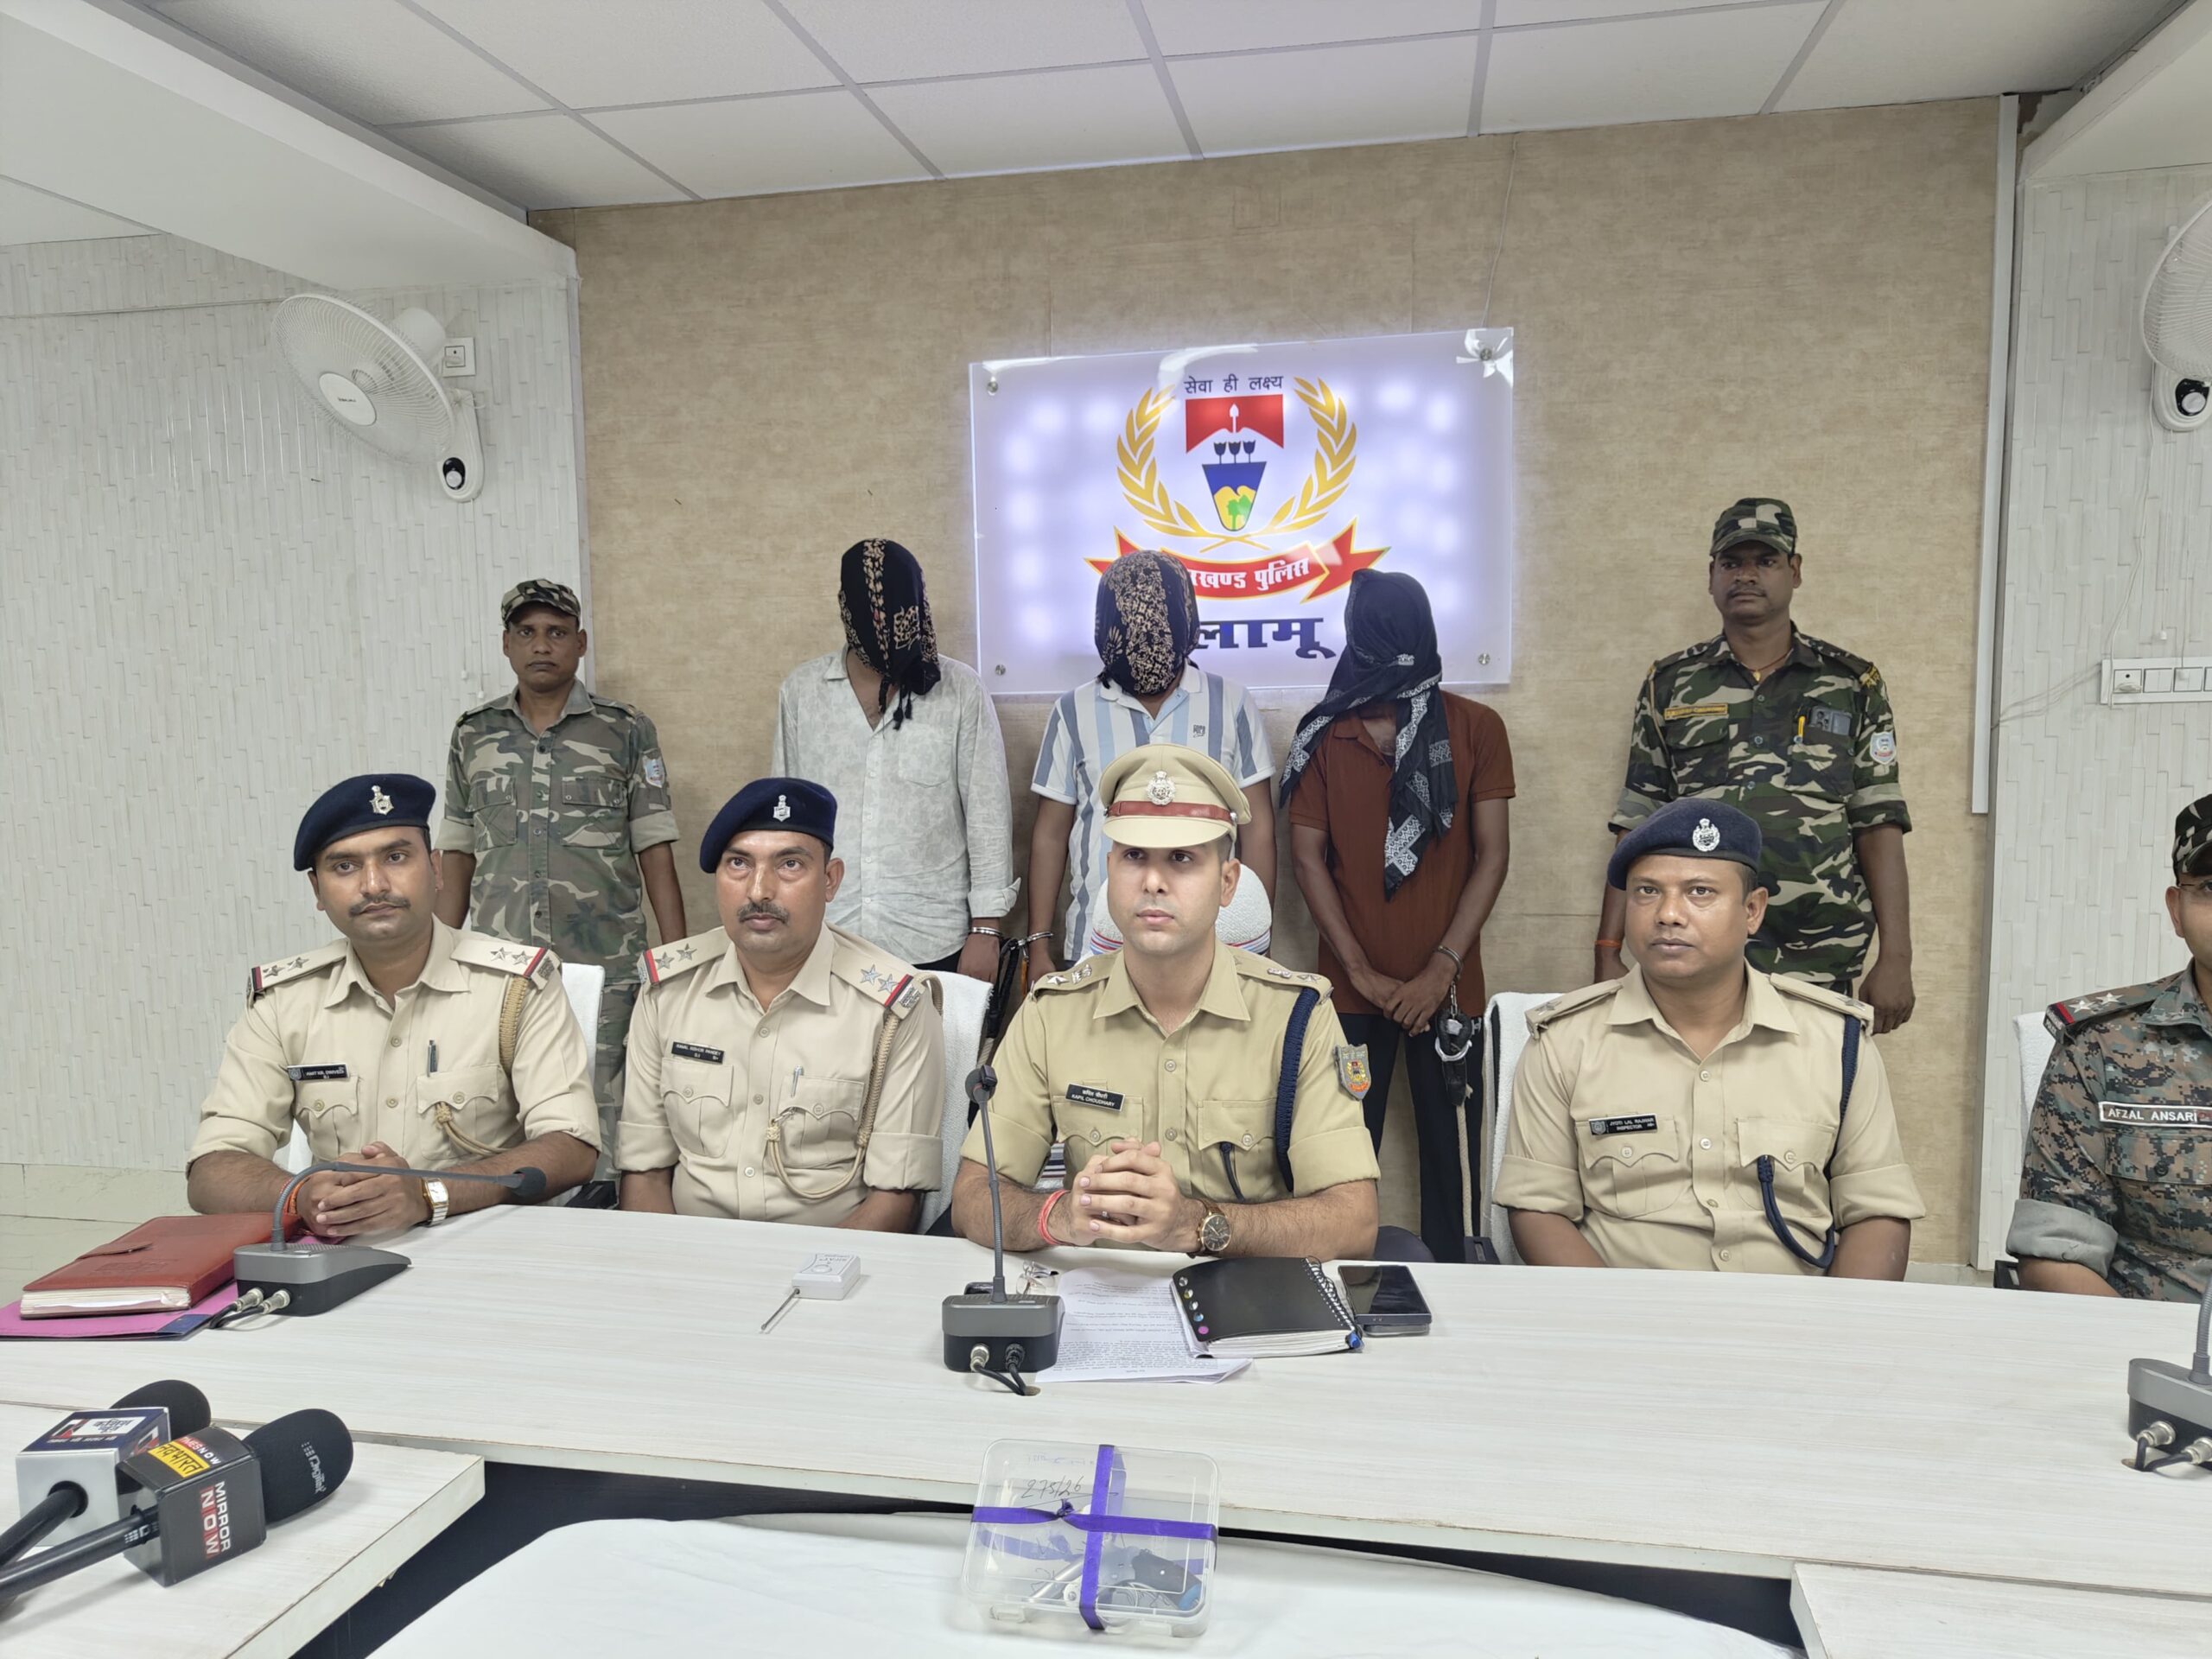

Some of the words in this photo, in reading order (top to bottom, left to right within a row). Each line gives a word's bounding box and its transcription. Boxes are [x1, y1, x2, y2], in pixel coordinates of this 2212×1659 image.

[1184, 375, 1213, 394] सेवा
[1223, 373, 1239, 393] ही
[1248, 376, 1284, 391] लक्ष्य
[1188, 569, 1247, 589] रखण्ड
[1254, 557, 1310, 591] पुलिस
[1196, 618, 1337, 659] लामू
[1085, 1096, 1116, 1107] CHOUDHARY
[2107, 1108, 2145, 1121] AFZAL
[2151, 1109, 2197, 1122] ANSARI
[200, 1490, 220, 1554] NOW
[214, 1480, 232, 1553] MIRROR
